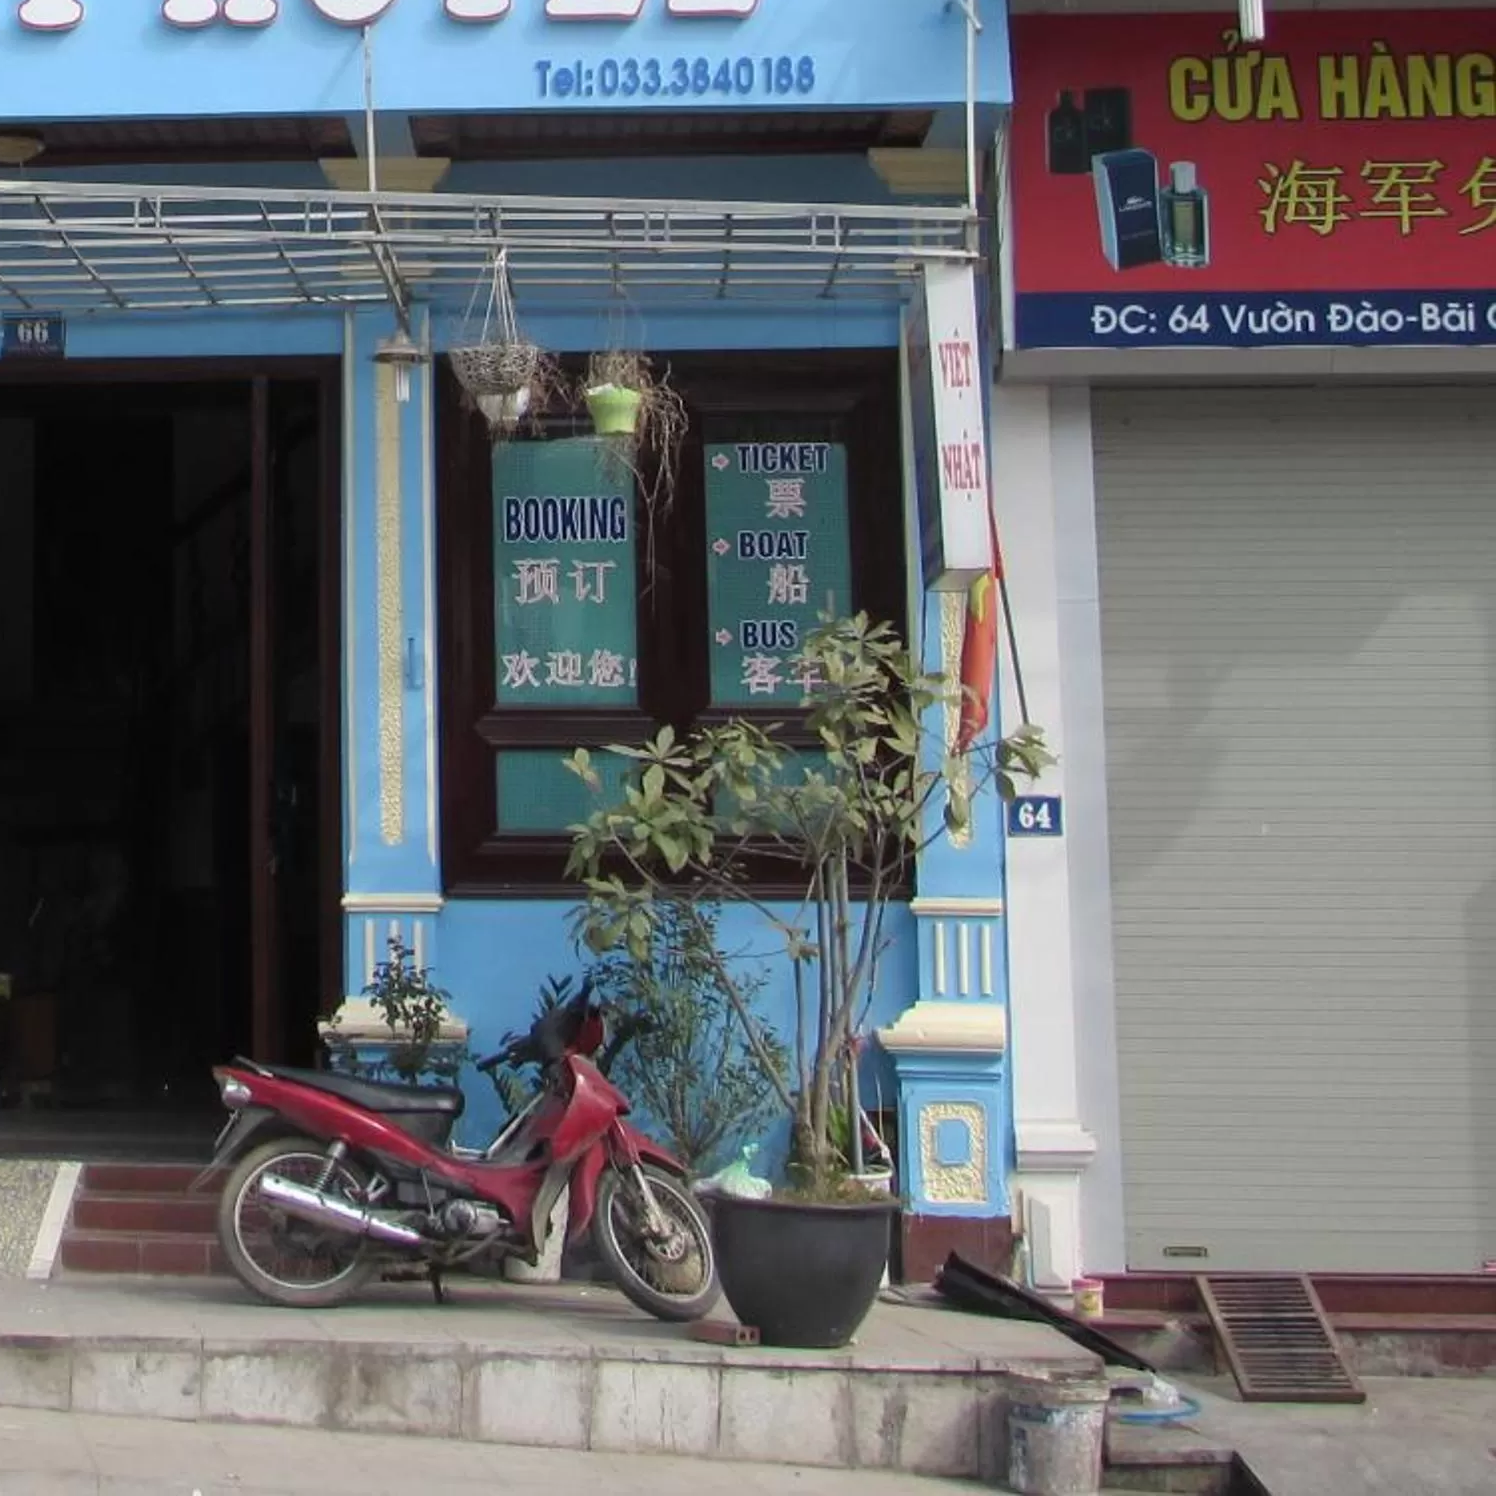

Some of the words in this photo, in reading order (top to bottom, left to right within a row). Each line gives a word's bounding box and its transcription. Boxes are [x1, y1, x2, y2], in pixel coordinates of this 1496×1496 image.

[1169, 28, 1301, 122] CỬA
[1317, 39, 1496, 120] HÀNG
[17, 319, 50, 344] 66
[1090, 304, 1157, 335] ĐC:
[1168, 304, 1210, 334] 64
[1221, 300, 1316, 334] Vườn
[737, 443, 830, 474] TICKET
[765, 478, 807, 520] 票
[504, 497, 628, 543] BOOKING
[737, 530, 809, 560] BOAT
[766, 562, 811, 606] 船
[740, 619, 799, 651] BUS
[1017, 803, 1052, 830] 64
